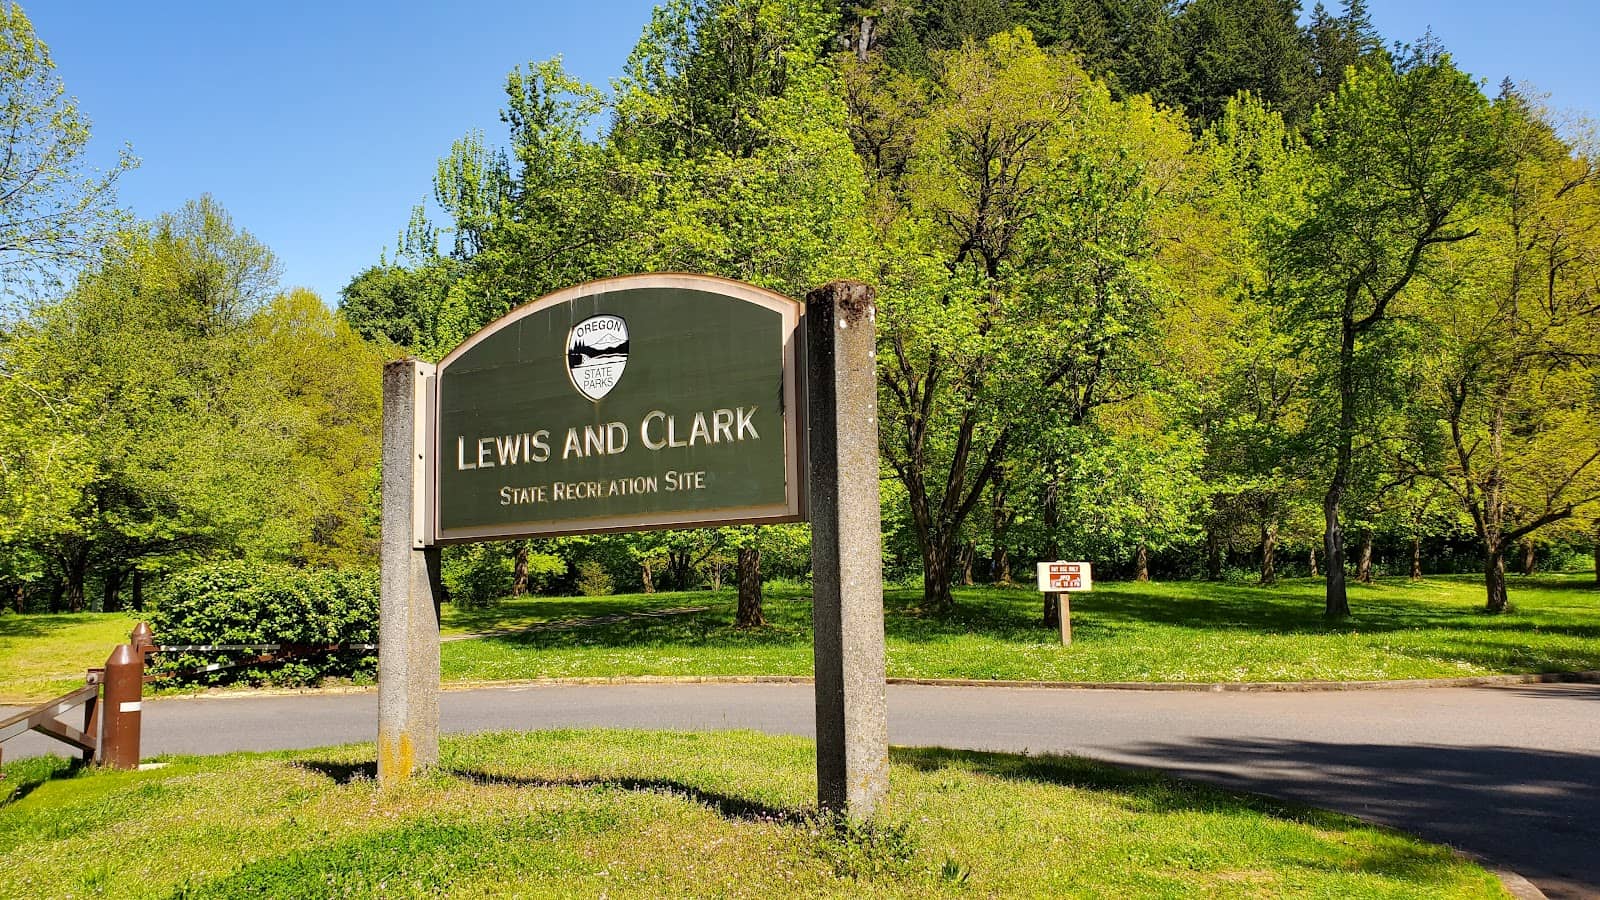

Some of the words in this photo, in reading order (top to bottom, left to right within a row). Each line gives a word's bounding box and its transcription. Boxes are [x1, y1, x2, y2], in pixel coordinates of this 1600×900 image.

[577, 320, 621, 337] OREGON
[584, 367, 612, 379] STATE
[583, 377, 613, 390] PARKS
[457, 430, 551, 470] LEWIS
[562, 421, 629, 460] AND
[641, 406, 760, 450] CLARK
[500, 484, 548, 505] STATE
[553, 476, 658, 501] RECREATION
[664, 470, 706, 492] SITE
